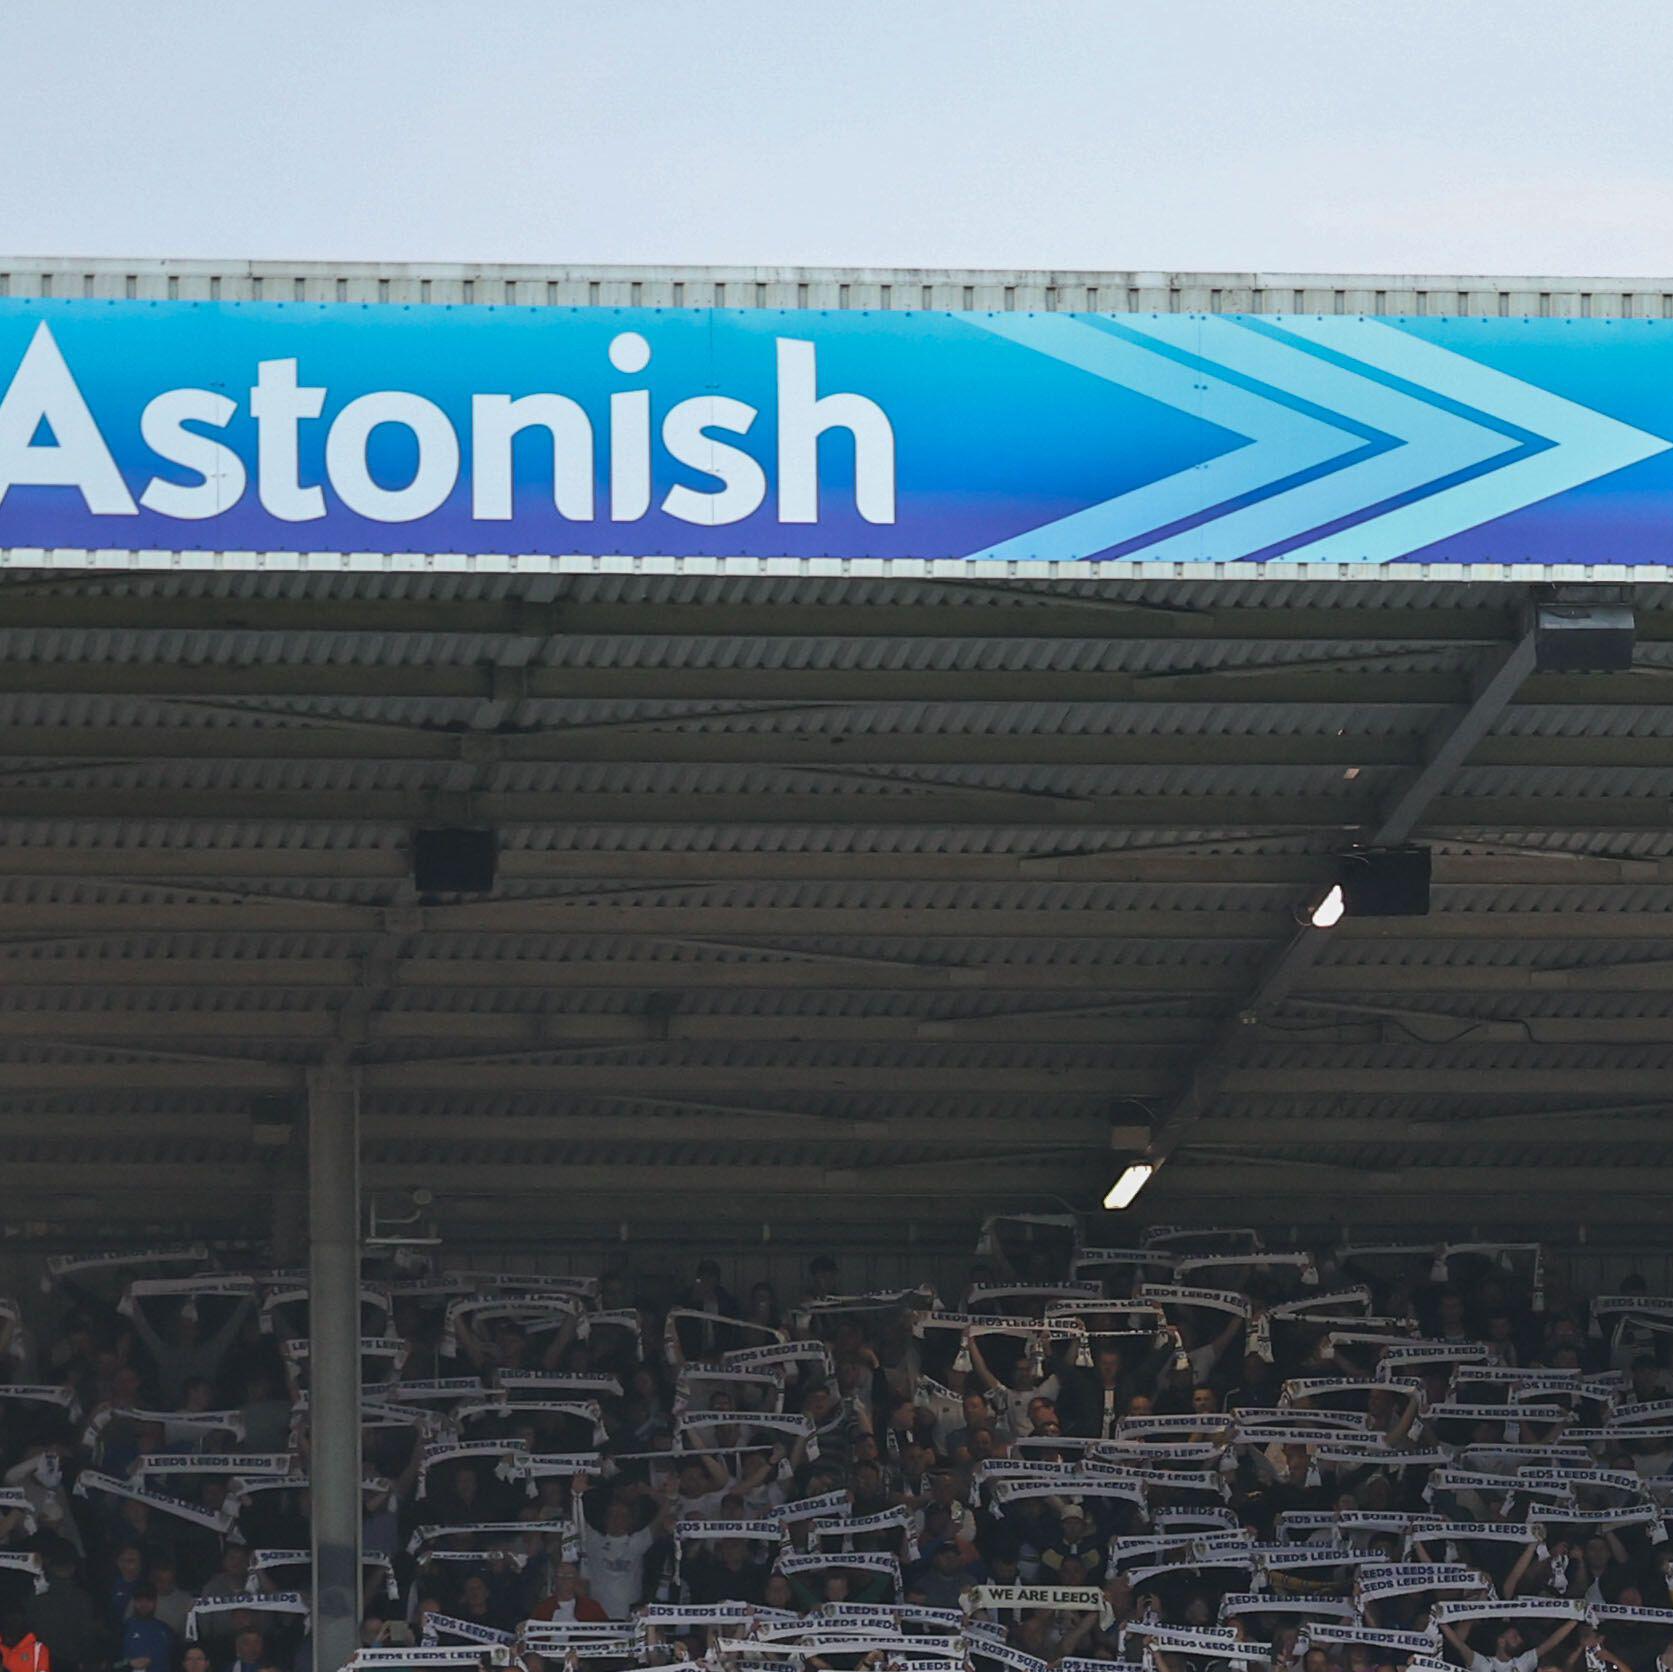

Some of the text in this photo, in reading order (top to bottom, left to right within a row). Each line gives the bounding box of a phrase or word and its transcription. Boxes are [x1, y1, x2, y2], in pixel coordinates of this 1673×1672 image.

[0, 319, 897, 527] Astonish
[1086, 1463, 1205, 1482] LEEDS LEEDS LEEDS
[989, 1589, 1098, 1604] WE ARE LEEDS
